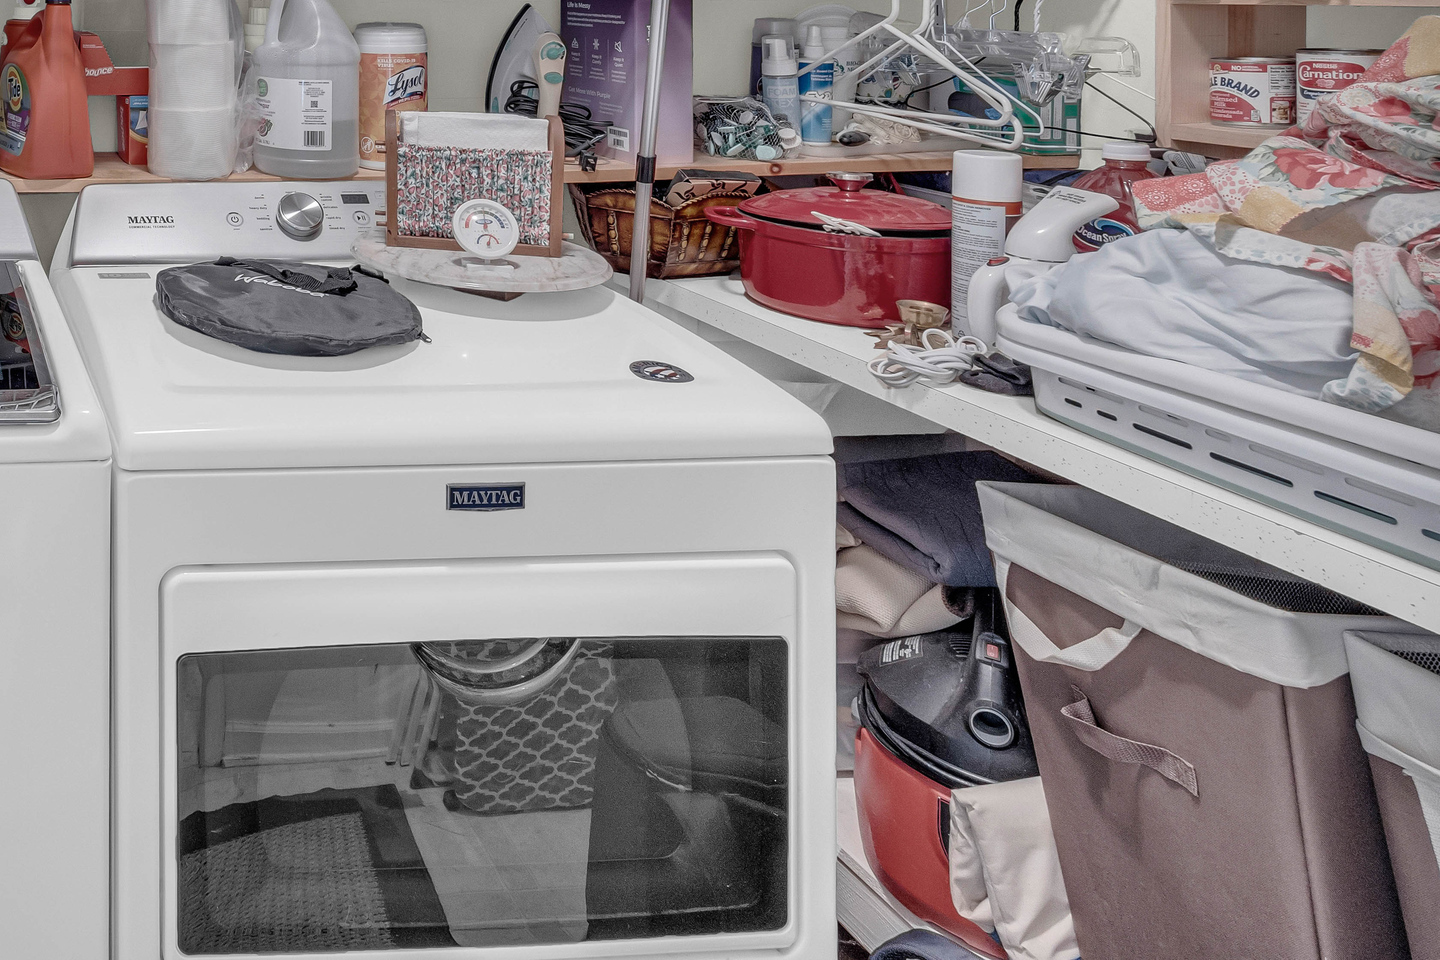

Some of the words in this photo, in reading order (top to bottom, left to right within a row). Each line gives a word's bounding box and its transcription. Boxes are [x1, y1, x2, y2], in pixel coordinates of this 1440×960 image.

[1300, 64, 1363, 81] Carnation
[388, 69, 423, 97] Lysol
[1220, 76, 1260, 99] BRAND
[596, 91, 611, 99] Purple
[768, 88, 796, 96] FOAM
[127, 215, 175, 224] MAYTAG
[1076, 226, 1103, 242] Ocean
[452, 490, 521, 505] MAYTAG
